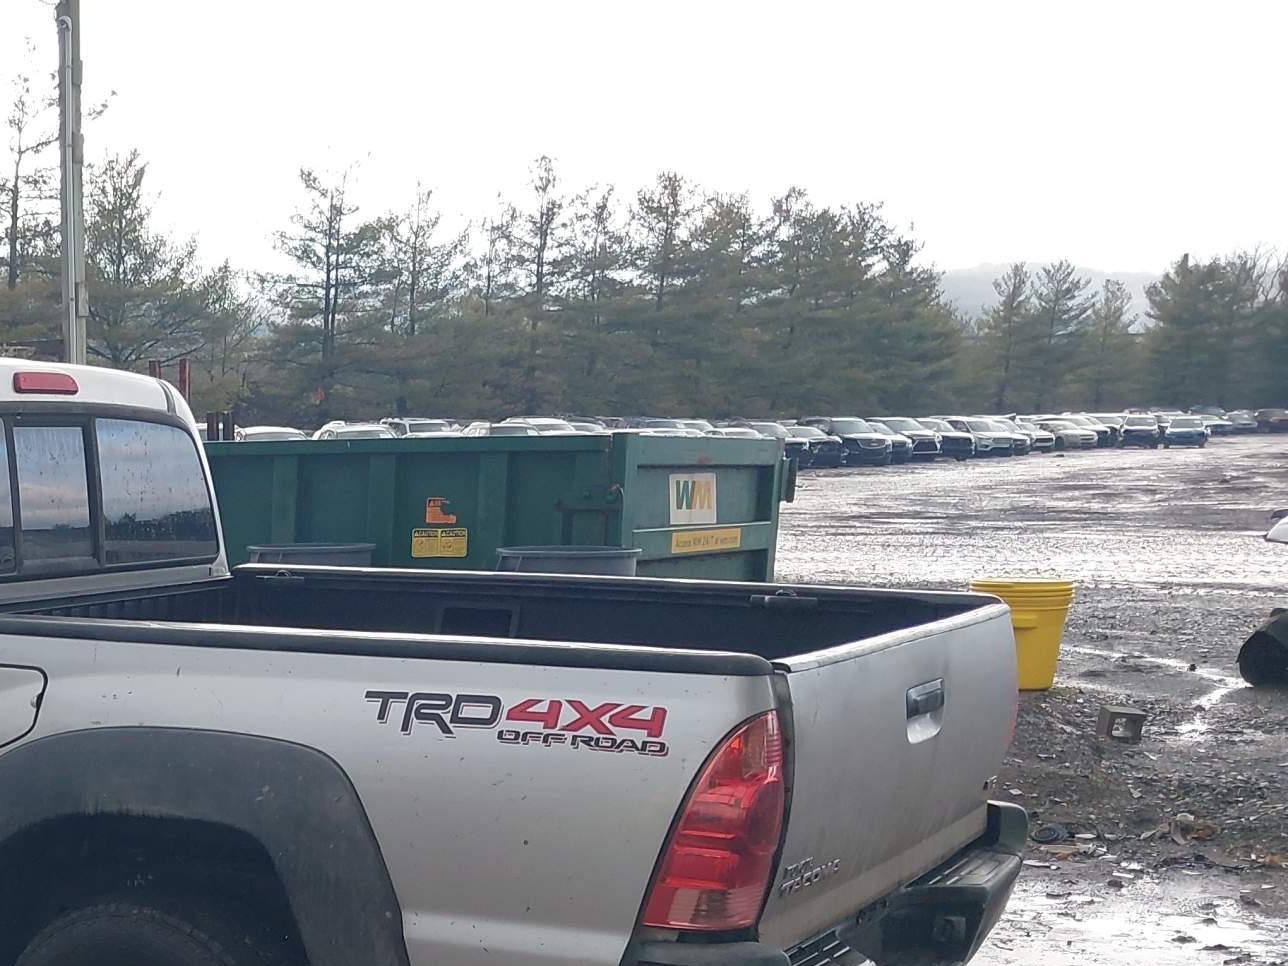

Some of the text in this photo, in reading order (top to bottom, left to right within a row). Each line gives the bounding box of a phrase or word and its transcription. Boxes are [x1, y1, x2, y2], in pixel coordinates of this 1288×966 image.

[675, 480, 713, 510] WM
[364, 690, 503, 738] TRD
[496, 728, 670, 757] OFF ROAD
